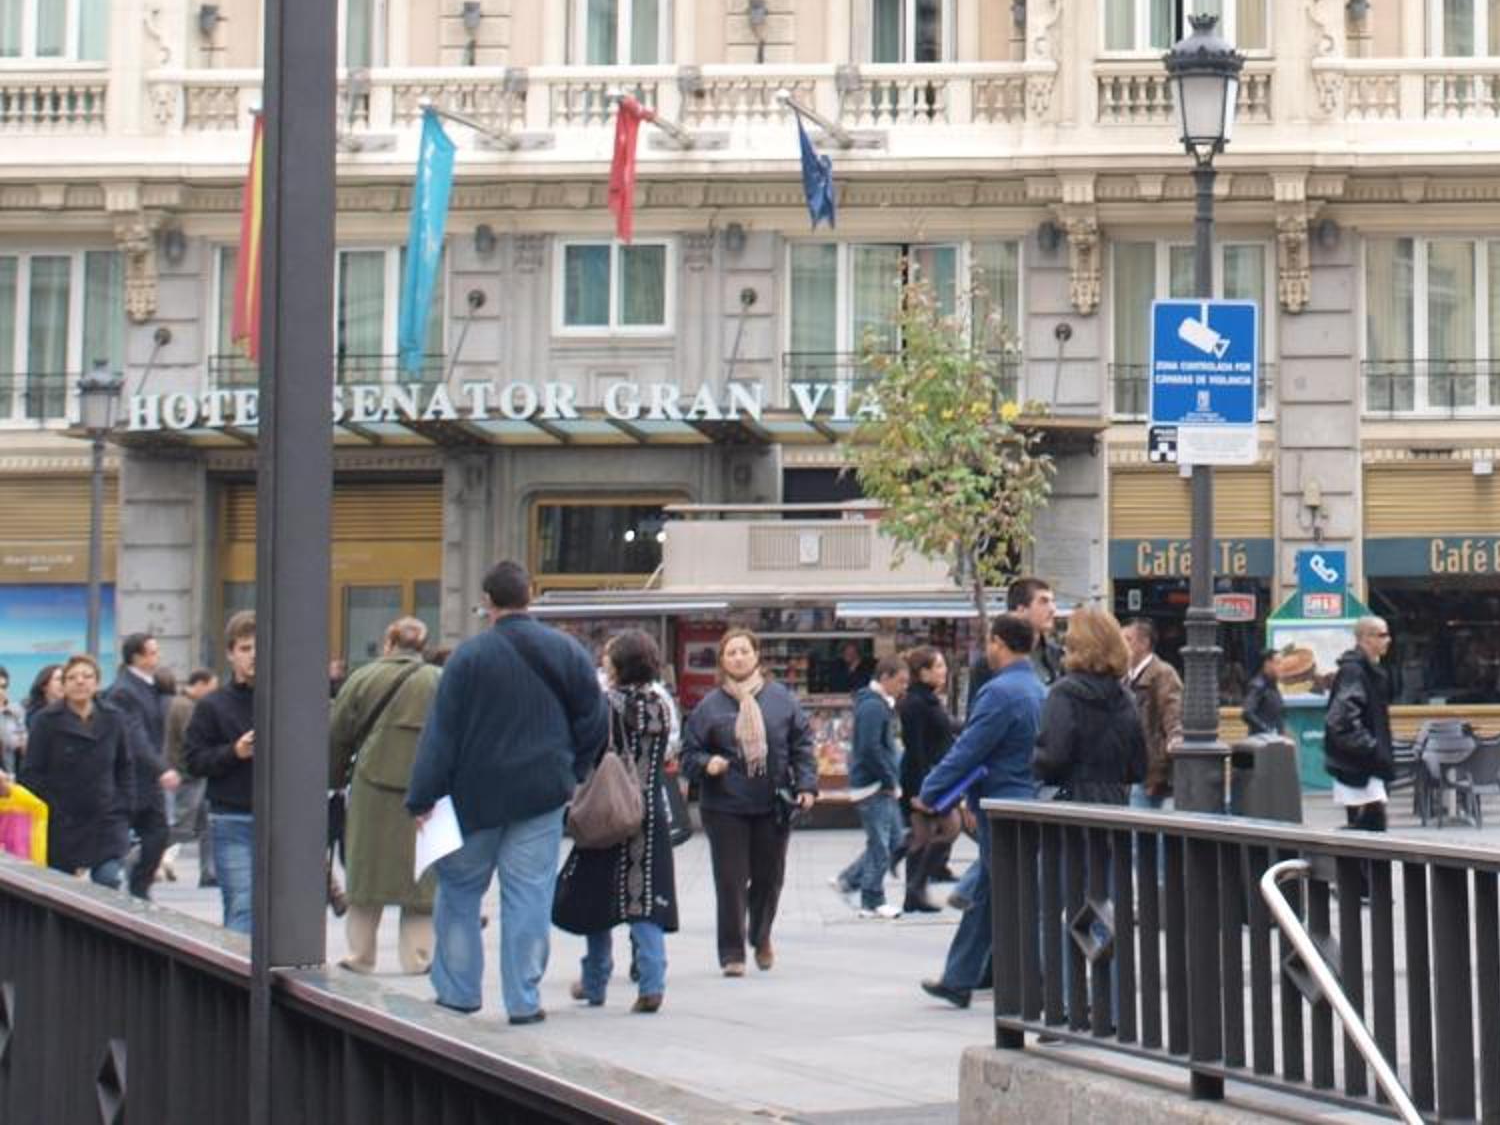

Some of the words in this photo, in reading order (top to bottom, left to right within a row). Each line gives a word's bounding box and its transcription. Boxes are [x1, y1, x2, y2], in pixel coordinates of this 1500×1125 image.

[128, 389, 259, 431] HOTE
[604, 381, 763, 422] GRAN
[1137, 541, 1192, 576] Café
[1219, 541, 1248, 576] Té
[1430, 539, 1488, 573] Café
